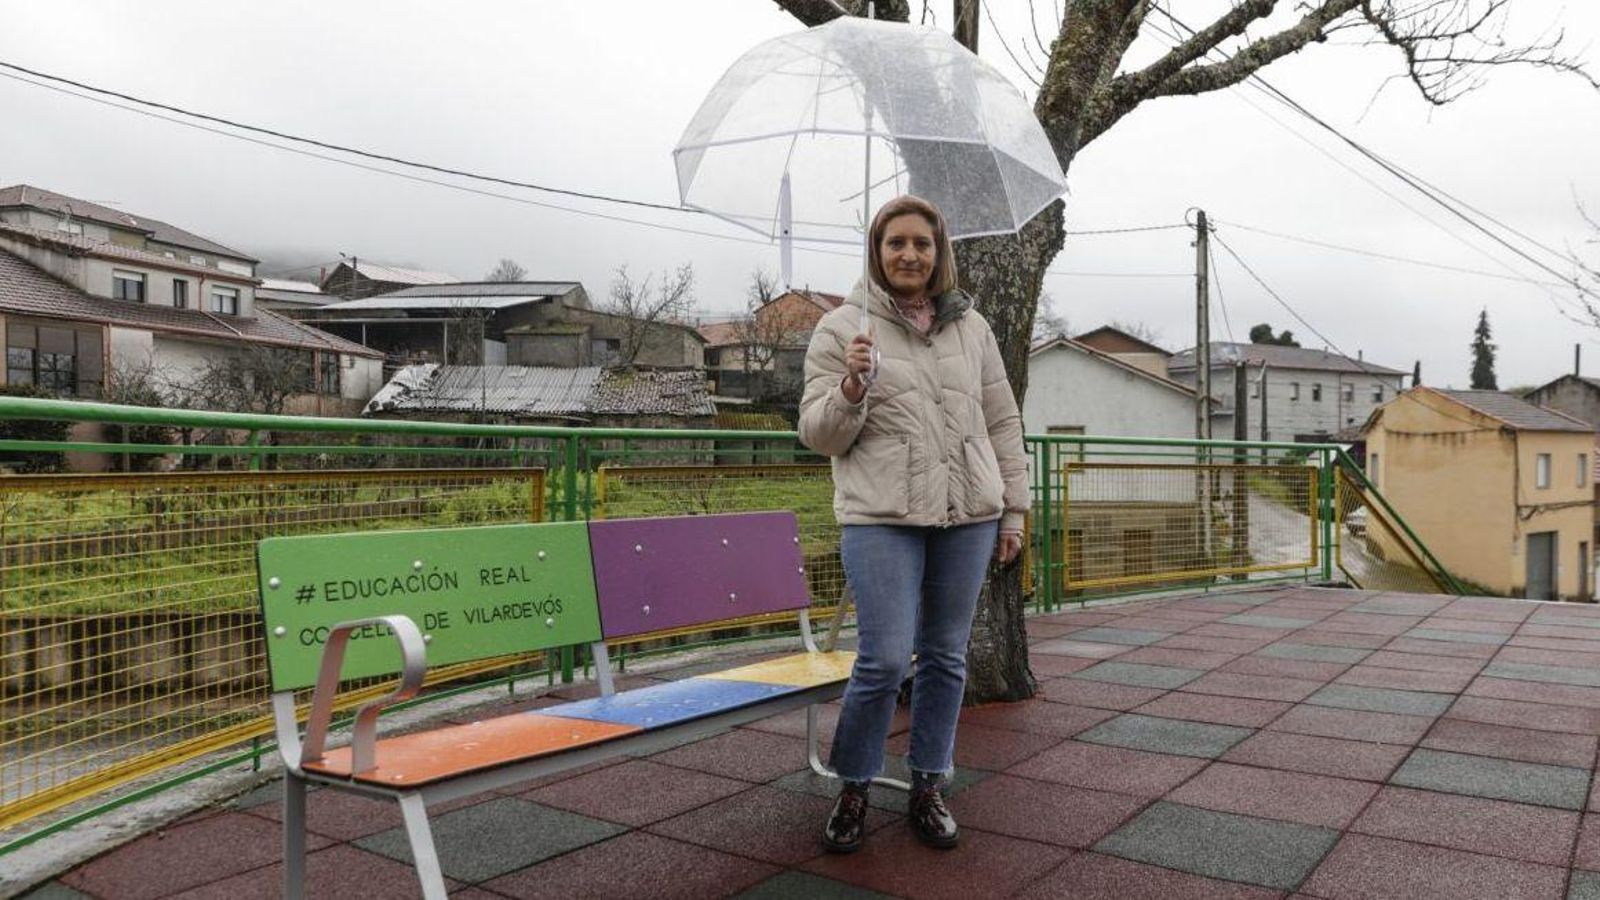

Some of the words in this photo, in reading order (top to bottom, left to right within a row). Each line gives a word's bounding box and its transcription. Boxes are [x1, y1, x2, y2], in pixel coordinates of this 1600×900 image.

[480, 565, 532, 586] REAL
[299, 621, 397, 646] COCELL
[424, 611, 450, 630] DE
[463, 593, 563, 624] VILARDEVÓS
